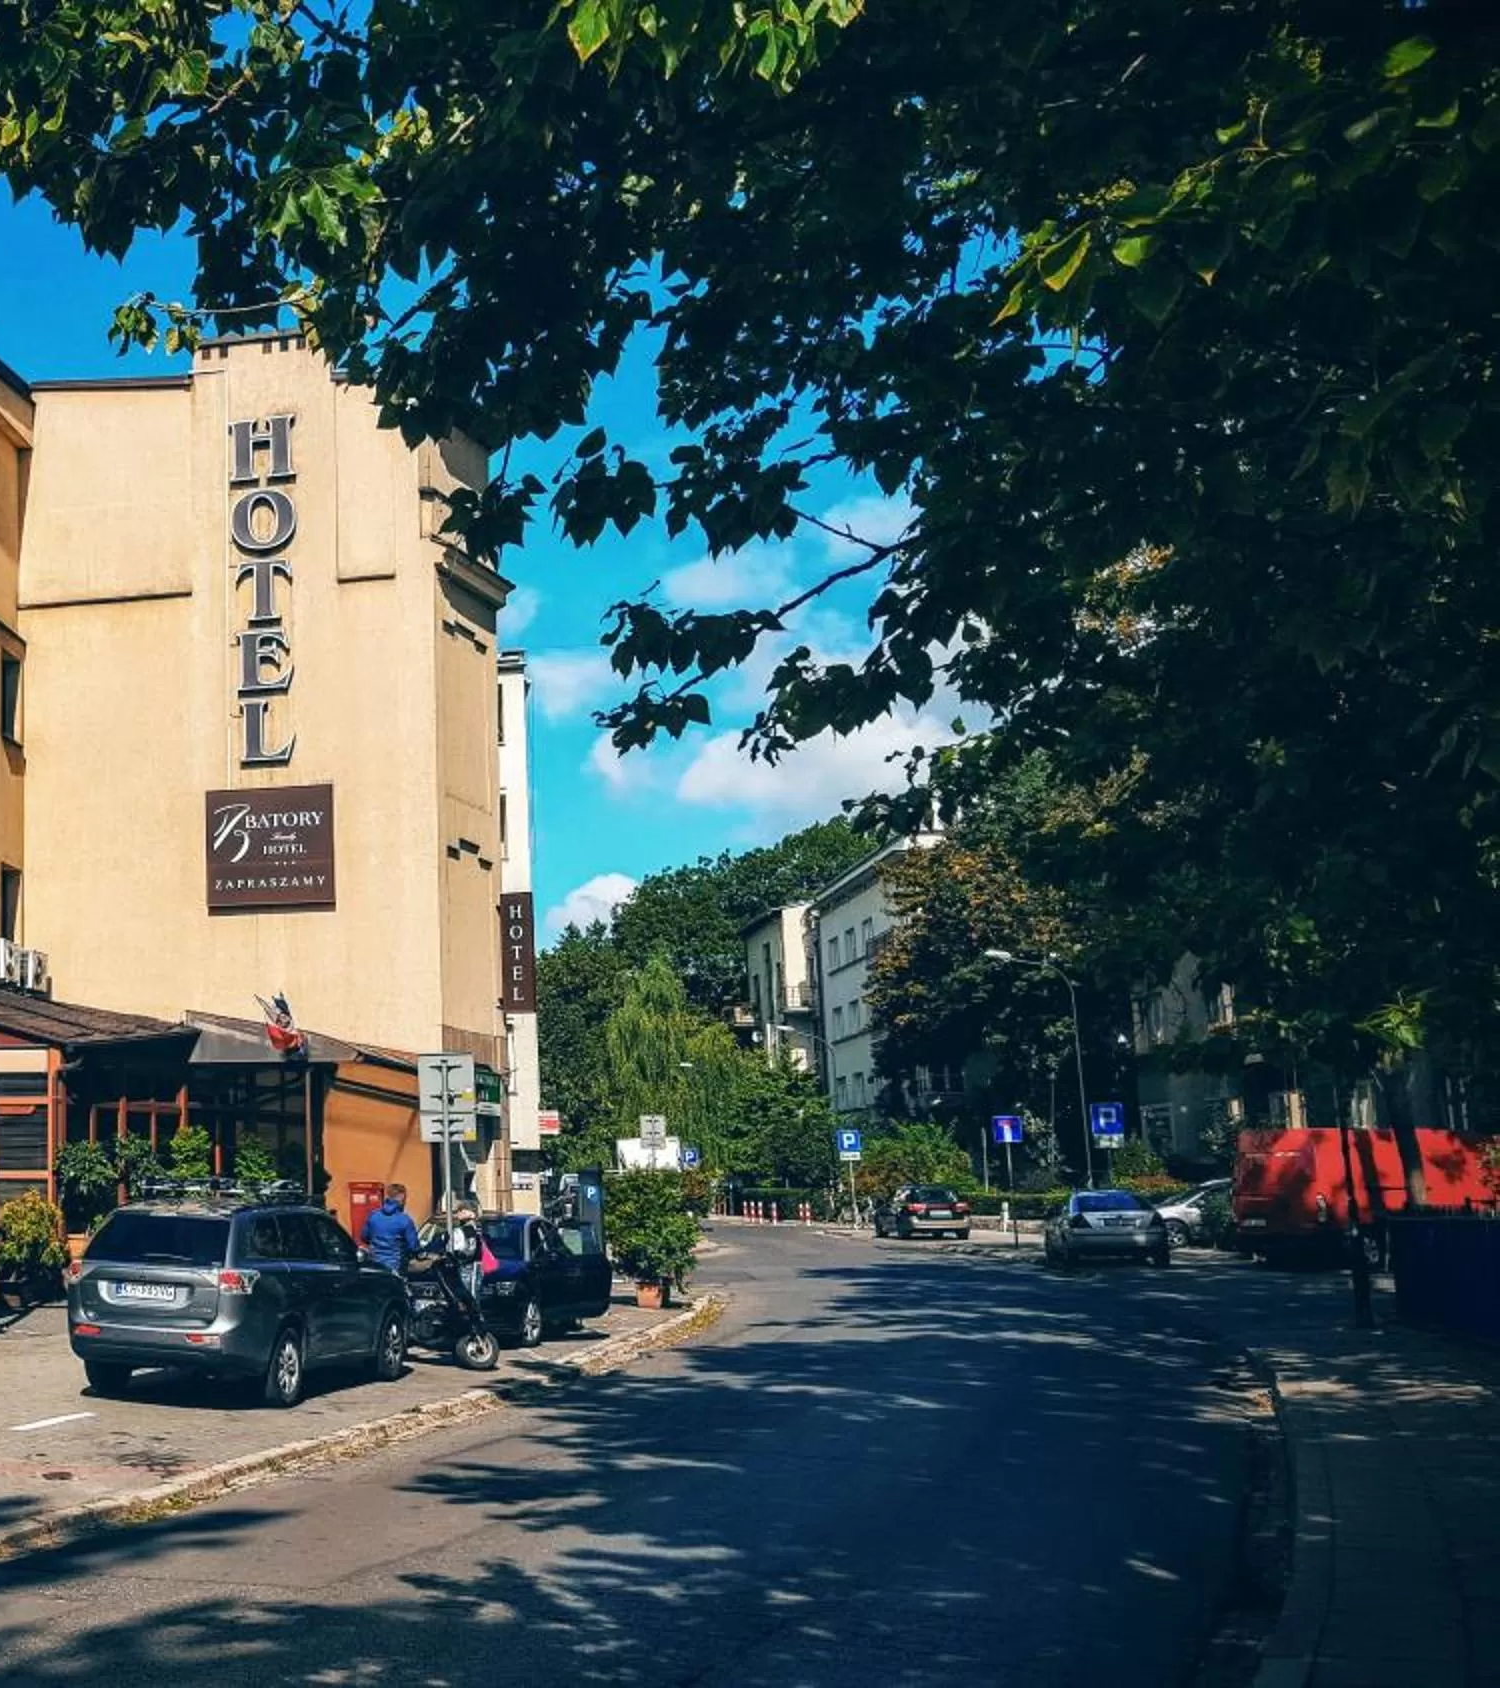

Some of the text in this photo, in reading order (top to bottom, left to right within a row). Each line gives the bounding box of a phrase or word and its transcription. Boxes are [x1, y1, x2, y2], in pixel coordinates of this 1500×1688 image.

[229, 414, 296, 766] HOTEL
[245, 811, 324, 829] BATORY
[263, 843, 307, 855] HOTEL
[215, 875, 325, 890] ZAPRASZAMY
[508, 904, 525, 1001] HOTEL
[1099, 1107, 1117, 1129] P
[843, 1133, 855, 1149] P
[685, 1151, 695, 1162] P
[587, 1186, 596, 1199] P
